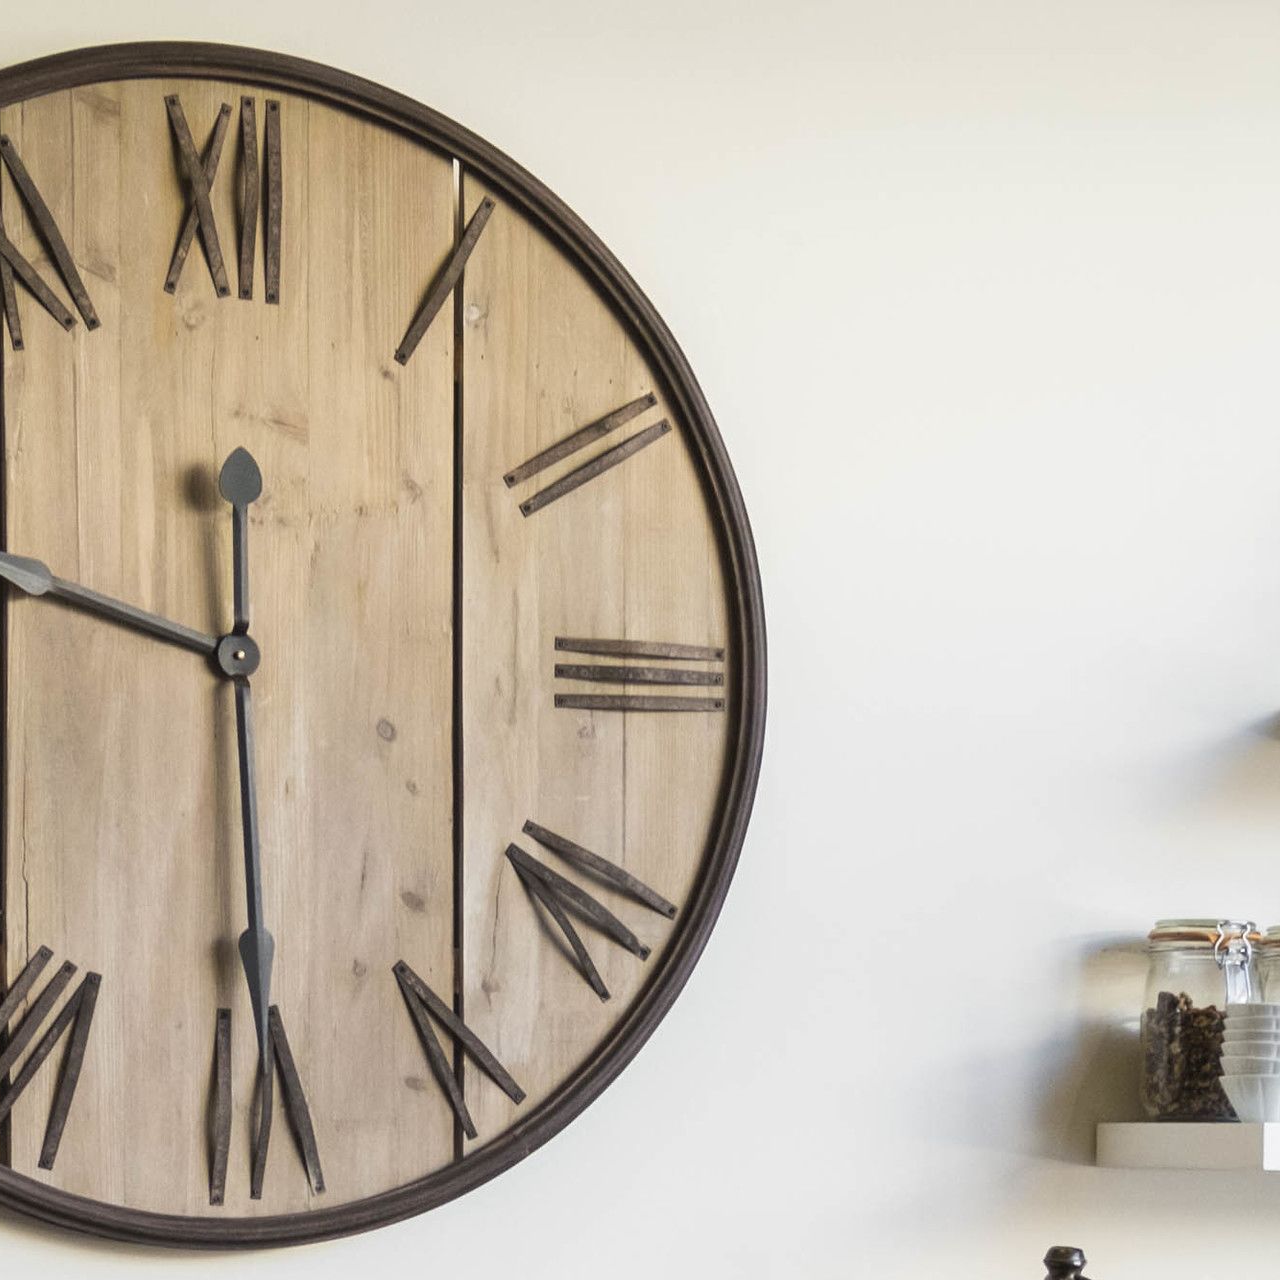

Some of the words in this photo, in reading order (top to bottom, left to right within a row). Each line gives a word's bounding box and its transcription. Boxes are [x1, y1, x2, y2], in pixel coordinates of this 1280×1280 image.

[163, 94, 282, 305] XII
[503, 391, 673, 518] II
[553, 635, 726, 713] III
[391, 957, 528, 1141] V
